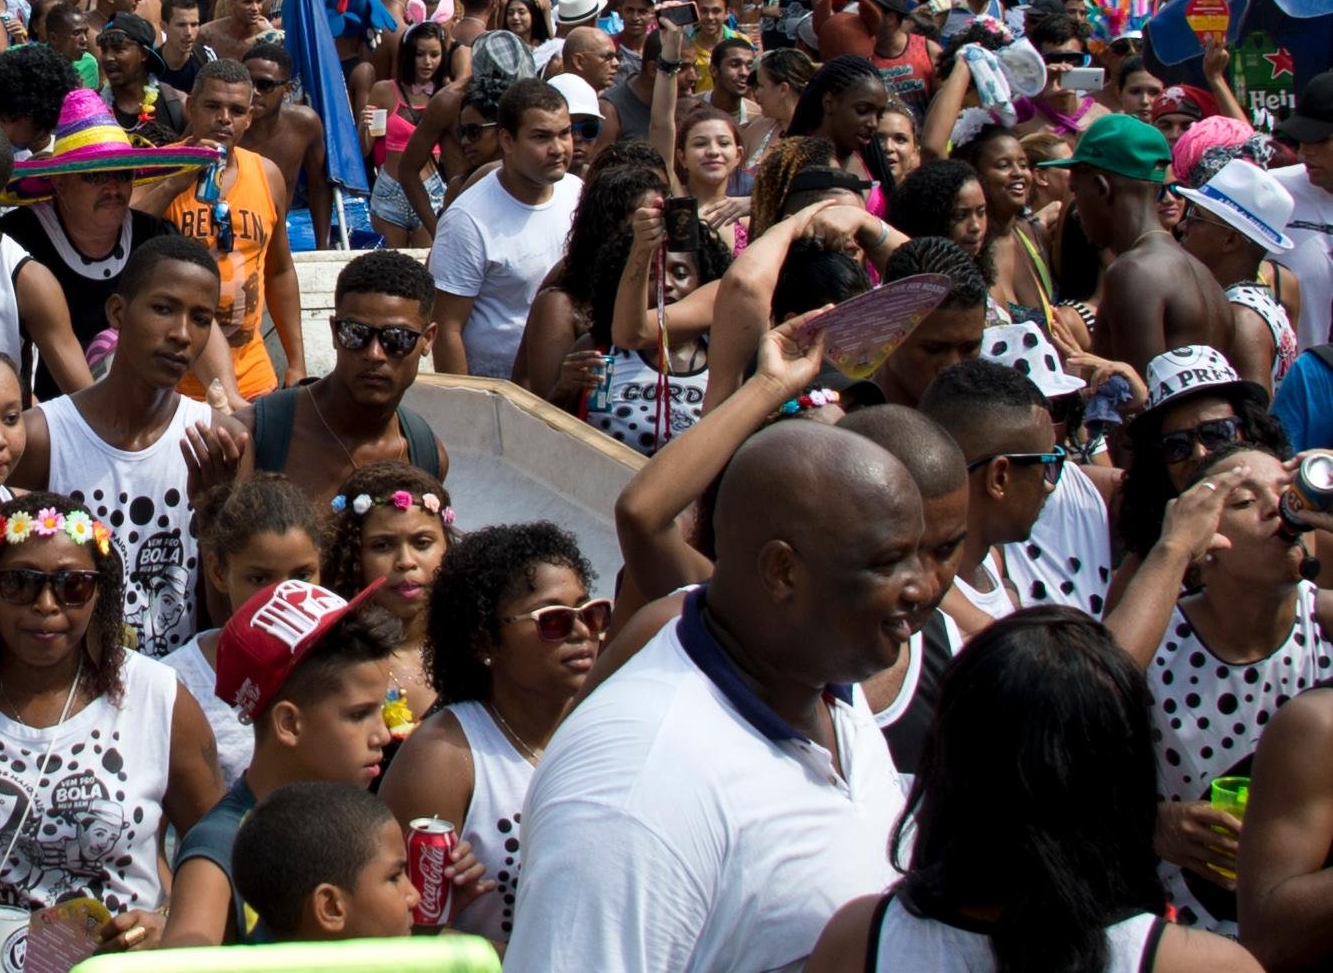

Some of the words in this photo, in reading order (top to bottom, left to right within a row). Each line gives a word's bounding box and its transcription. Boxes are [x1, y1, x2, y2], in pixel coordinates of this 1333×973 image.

[140, 547, 179, 564] BOLA
[56, 783, 103, 802] BOLA
[418, 841, 444, 918] Coca-Cola
